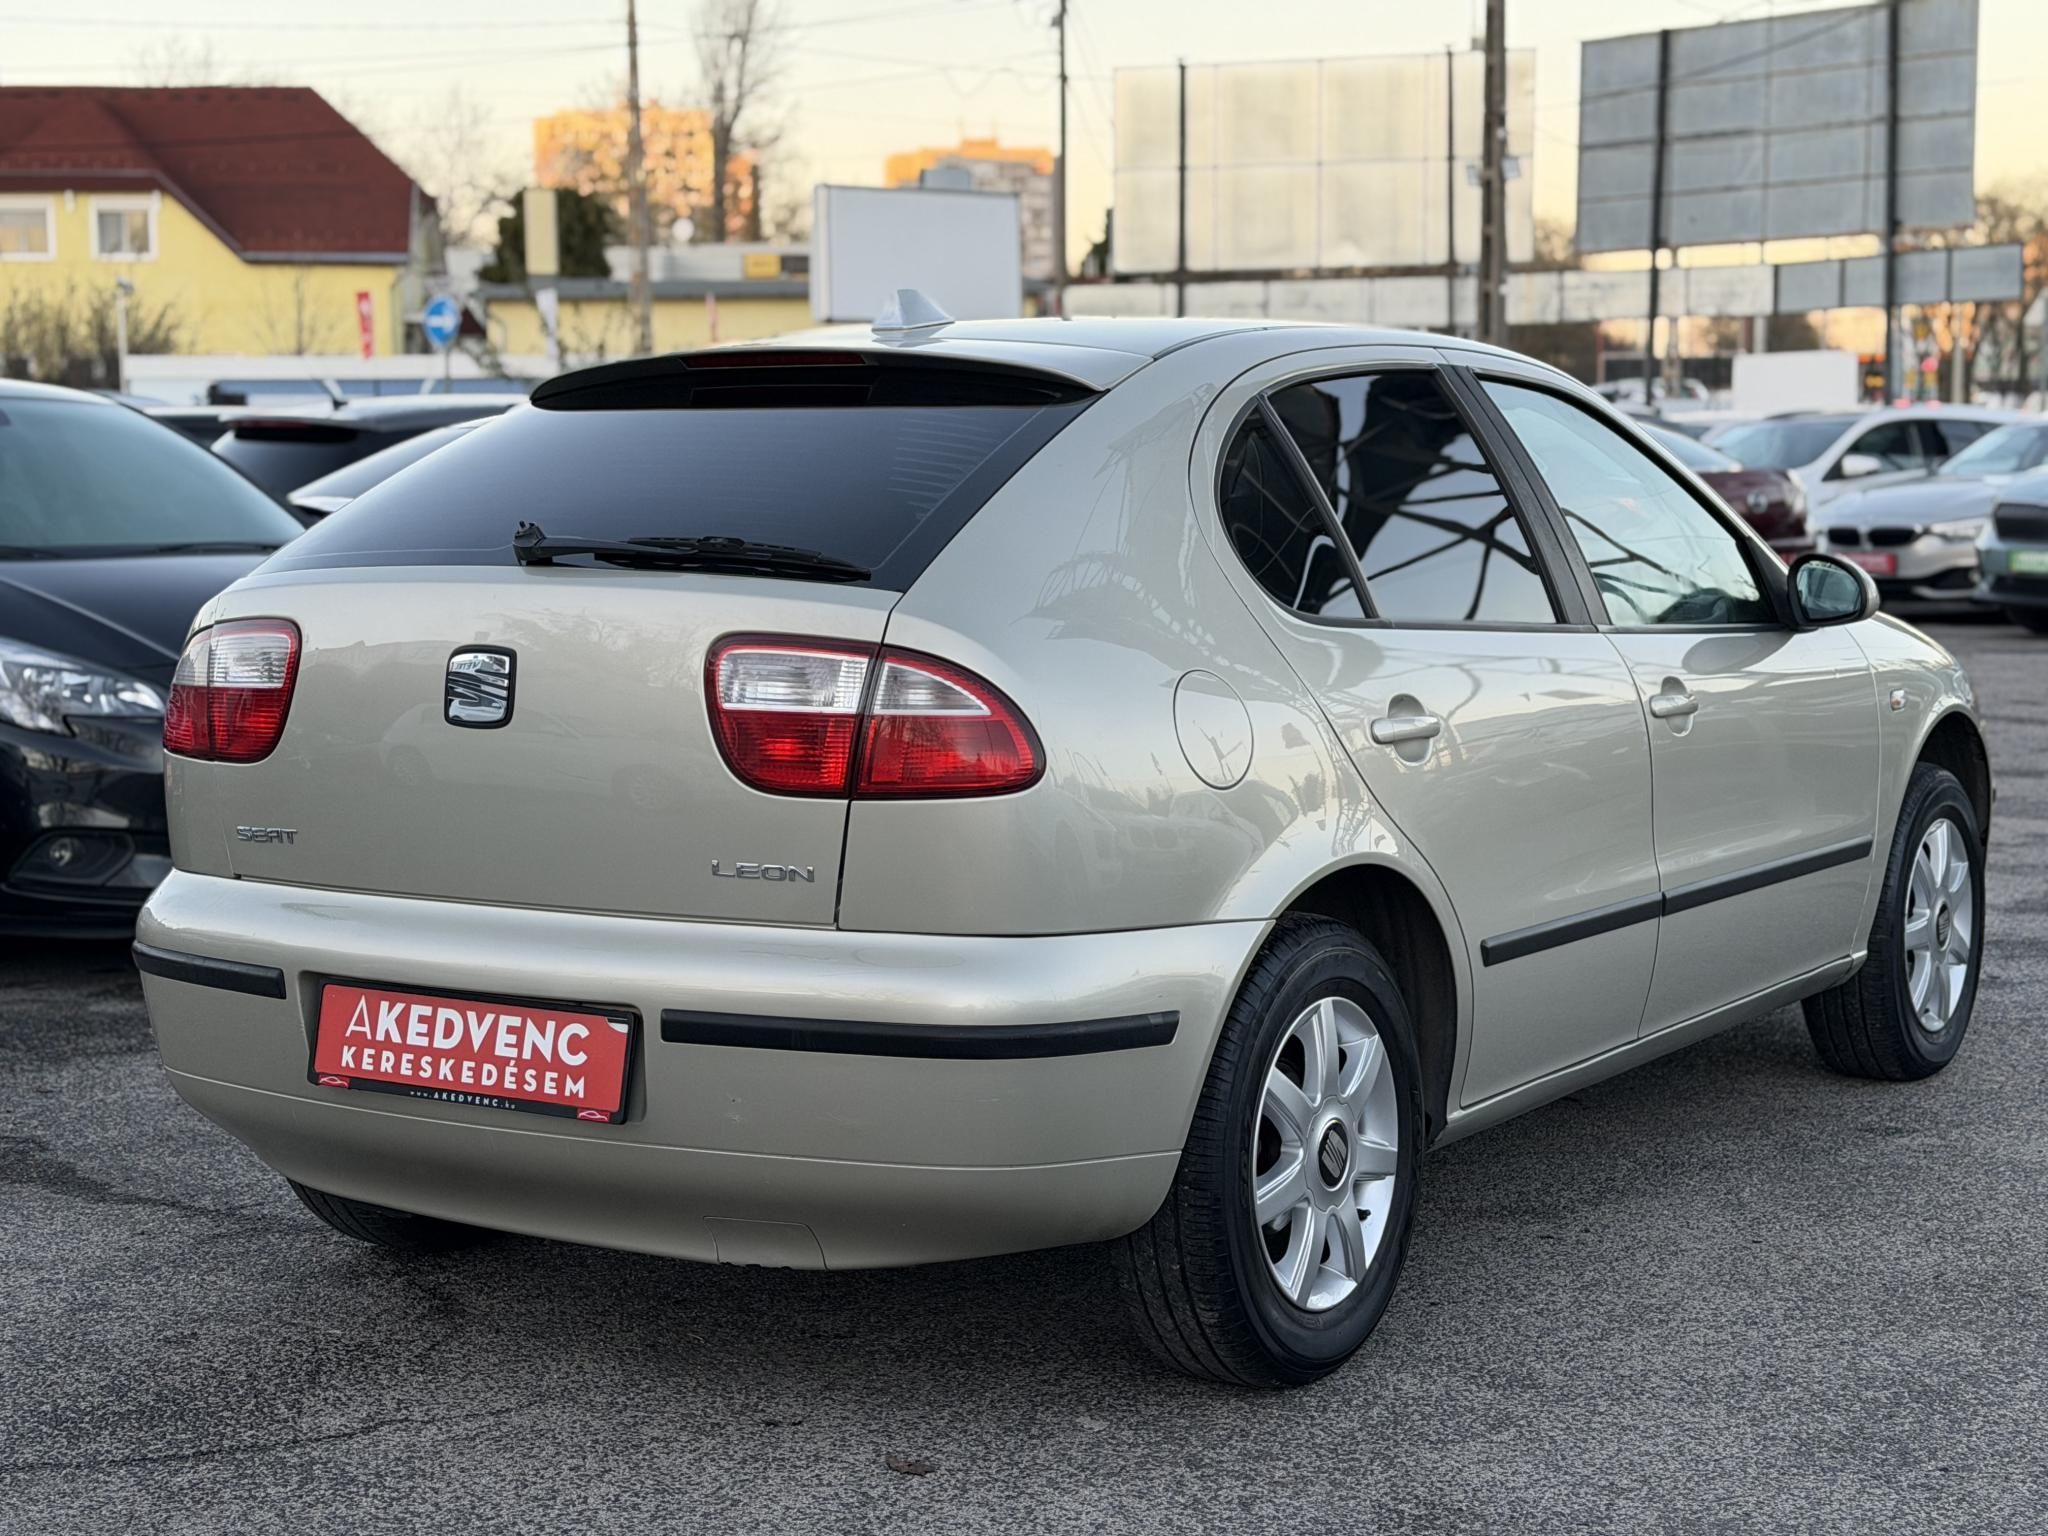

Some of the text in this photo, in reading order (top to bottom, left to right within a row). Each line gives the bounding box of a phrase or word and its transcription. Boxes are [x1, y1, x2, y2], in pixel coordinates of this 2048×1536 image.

[237, 825, 298, 844] SEAT
[711, 859, 815, 883] LEON
[345, 994, 590, 1066] AKEDVENC
[341, 1045, 585, 1098] KERESKEDÉSEM
